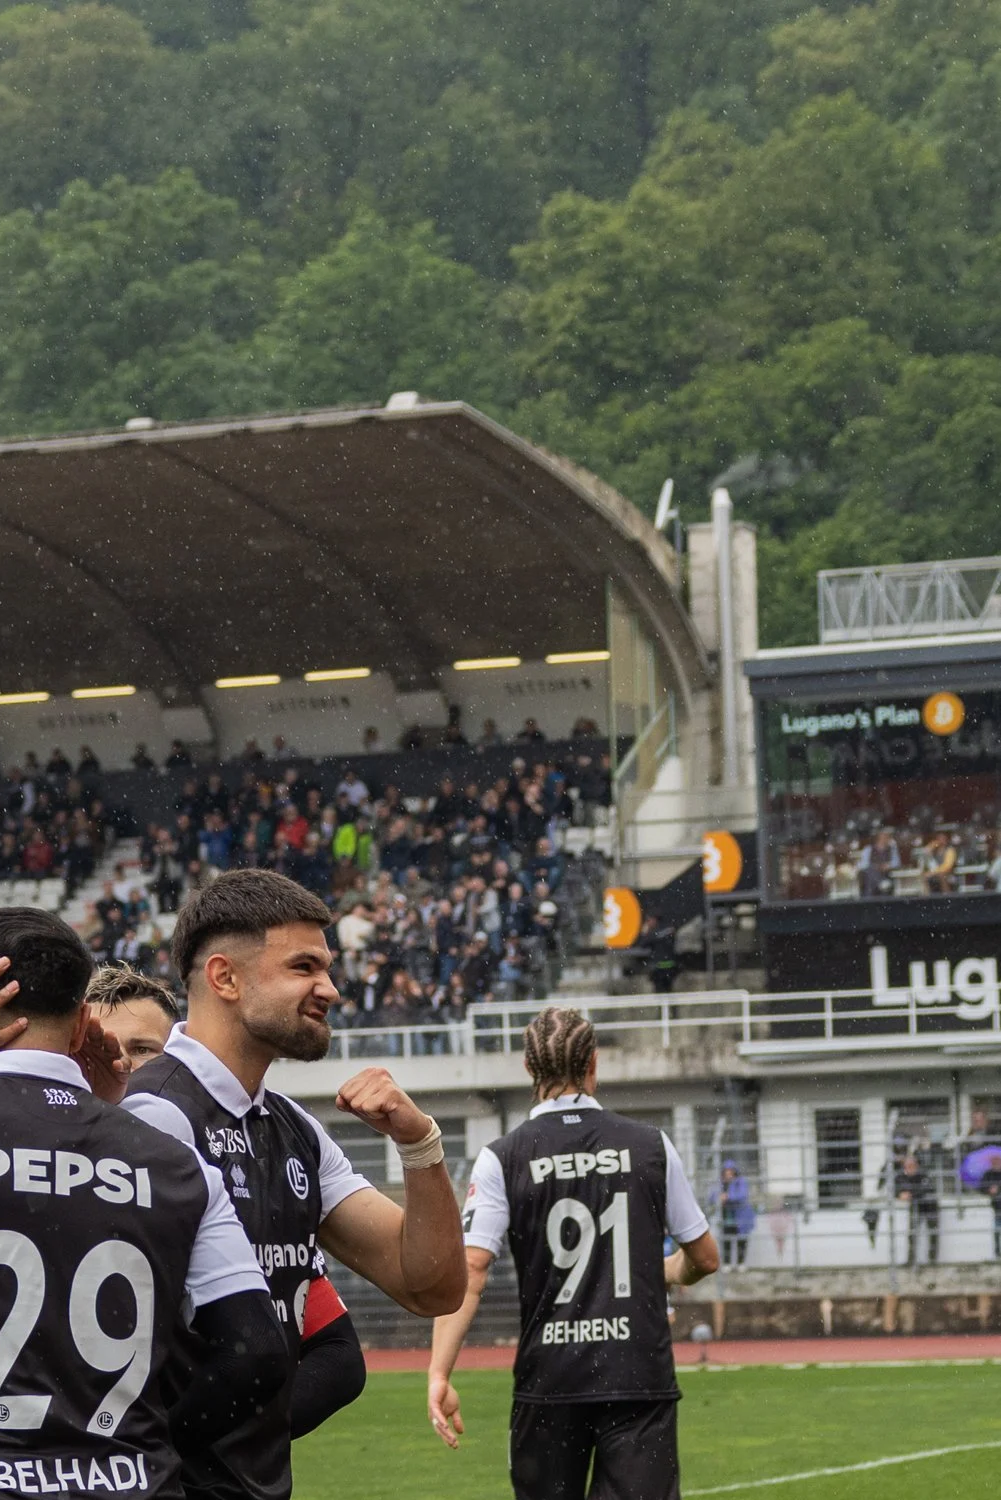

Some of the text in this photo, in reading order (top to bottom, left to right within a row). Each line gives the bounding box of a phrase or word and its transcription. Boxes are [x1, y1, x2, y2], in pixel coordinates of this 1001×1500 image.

[781, 708, 871, 737] Lugano's
[875, 705, 920, 727] Plan
[870, 945, 998, 1020] Lug
[529, 1149, 632, 1184] PEPSI
[546, 1192, 631, 1304] 91
[542, 1317, 630, 1344] BEHRENS
